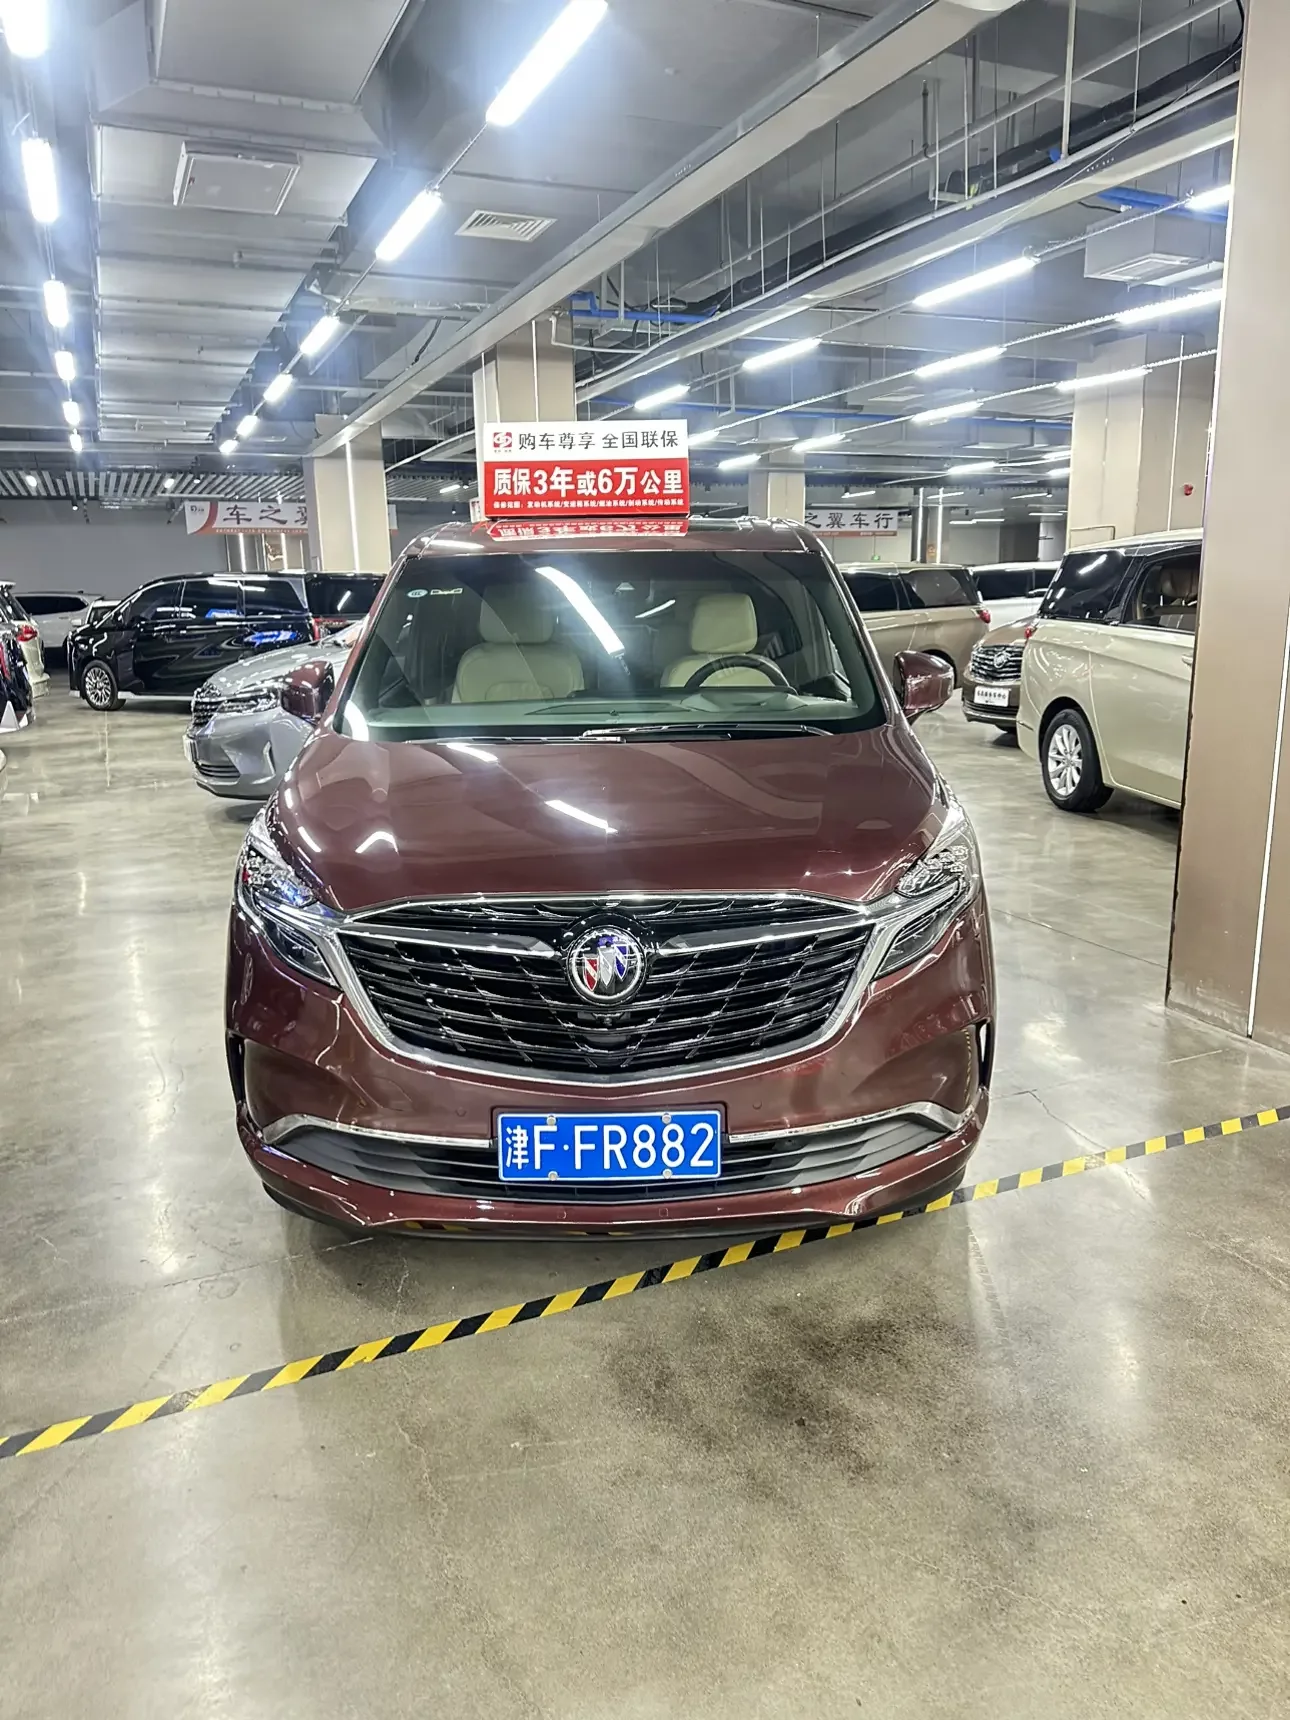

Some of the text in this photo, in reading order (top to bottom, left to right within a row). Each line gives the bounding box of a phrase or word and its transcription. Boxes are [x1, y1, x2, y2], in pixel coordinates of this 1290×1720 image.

[518, 430, 679, 451] 购车尊享 全国联保
[493, 466, 684, 497] 质保3年或6万公里
[505, 1122, 715, 1170] 津F·FR882
